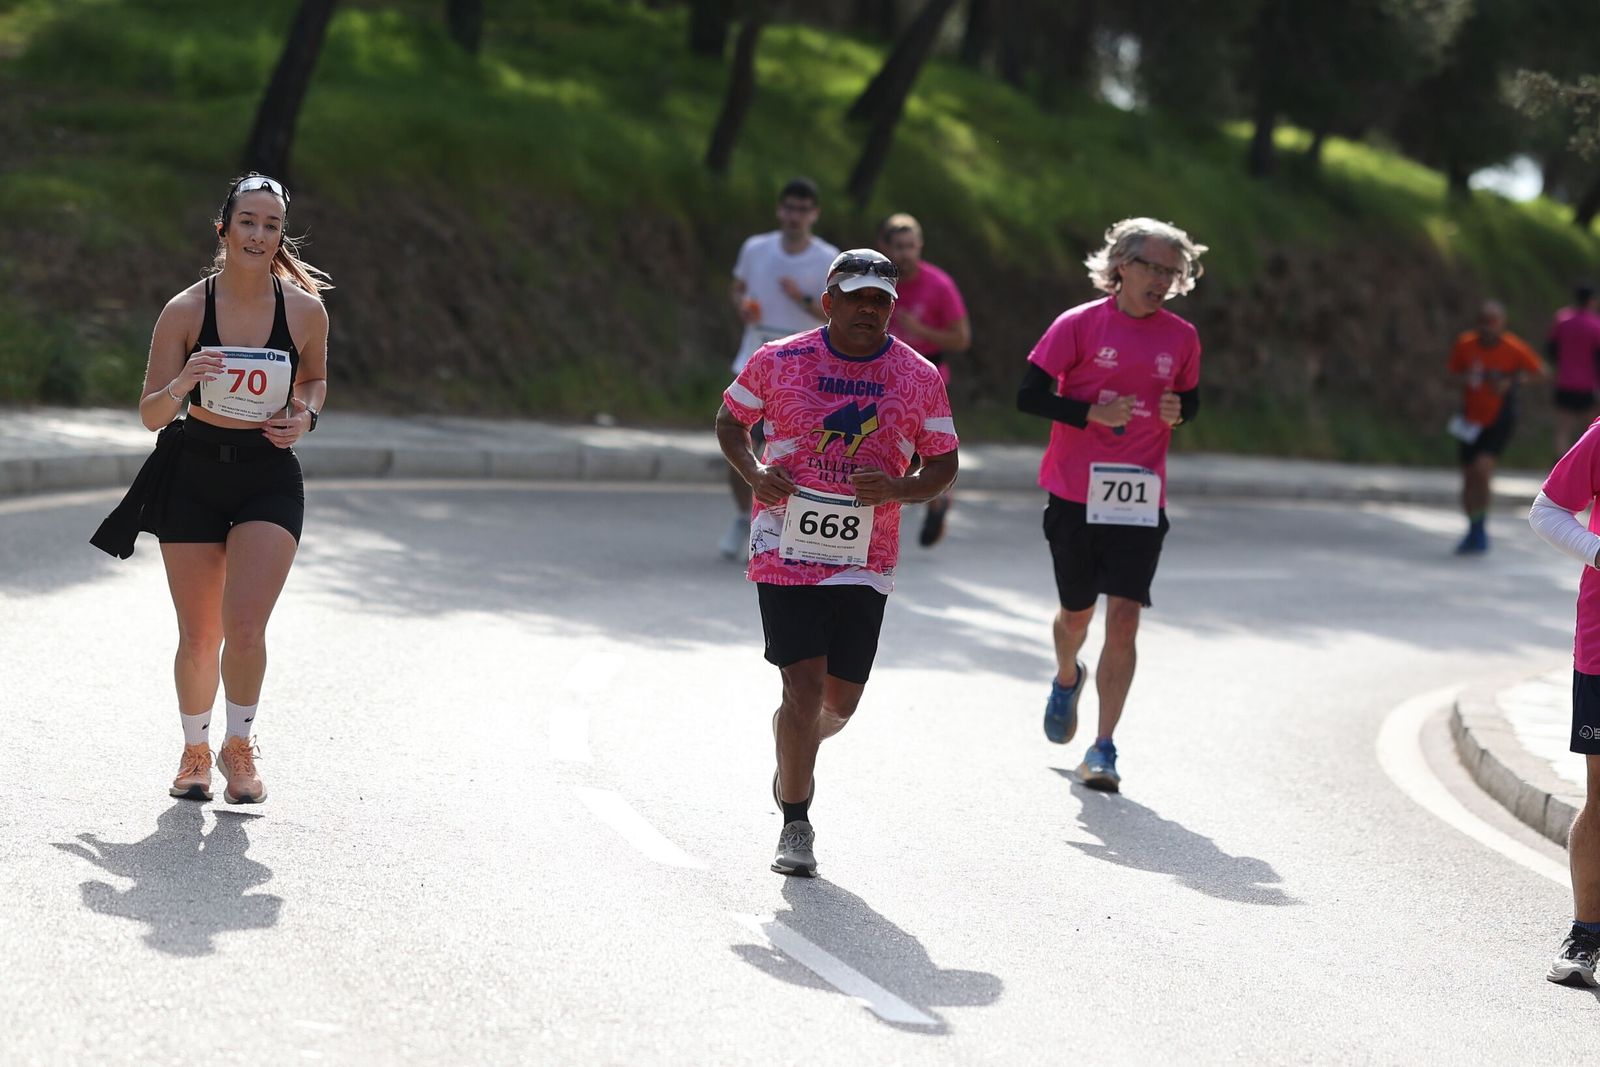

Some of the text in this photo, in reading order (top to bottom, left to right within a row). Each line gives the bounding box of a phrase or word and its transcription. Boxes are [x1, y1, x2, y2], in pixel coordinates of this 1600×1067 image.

[227, 368, 267, 396] 70
[817, 376, 886, 398] TARACHE
[1102, 480, 1148, 504] 701
[799, 510, 861, 541] 668
